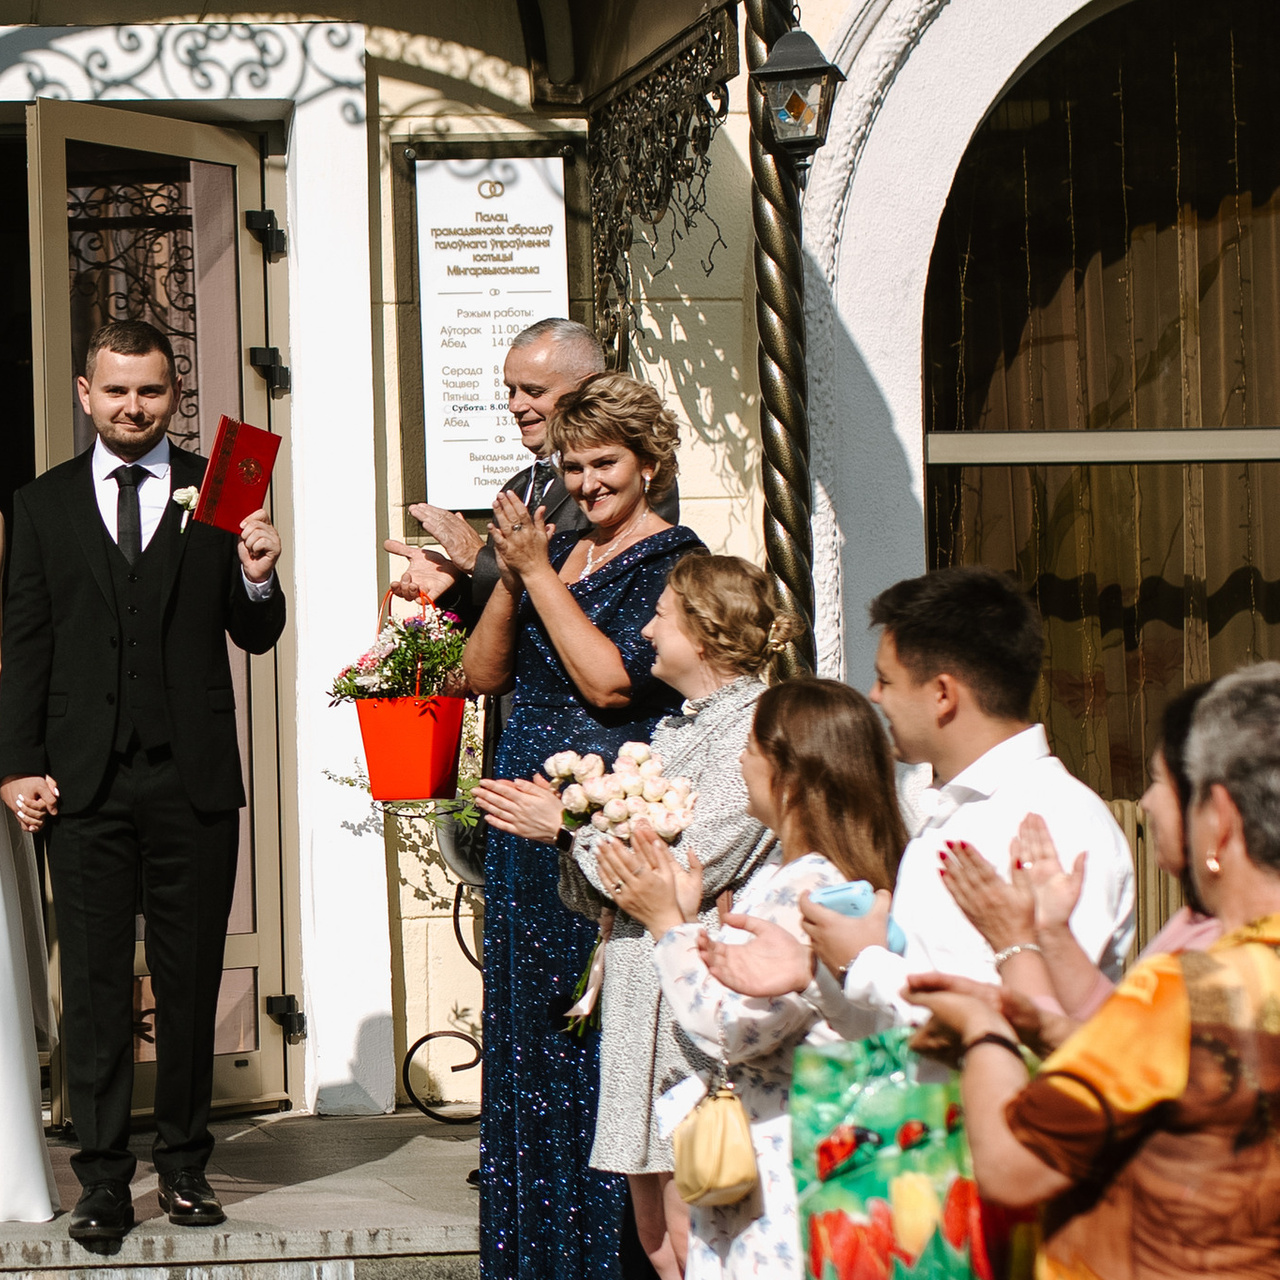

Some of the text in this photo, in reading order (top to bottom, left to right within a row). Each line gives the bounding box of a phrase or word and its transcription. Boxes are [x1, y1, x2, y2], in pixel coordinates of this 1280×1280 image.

[475, 211, 509, 223] Палац
[457, 307, 535, 320] Рэжым работы:
[440, 324, 529, 337] Аўторак 11.00-2
[440, 338, 513, 349] Абед 14.0
[441, 366, 483, 377] Серада
[442, 378, 480, 390] Чацвер
[443, 391, 480, 402] Пятніца
[452, 403, 509, 414] Субота: 8.00
[443, 416, 518, 428] Абед 13.0
[469, 451, 532, 462] Выхадныя дні:
[482, 464, 520, 474] Нядзеля
[474, 477, 507, 487] Панядз
